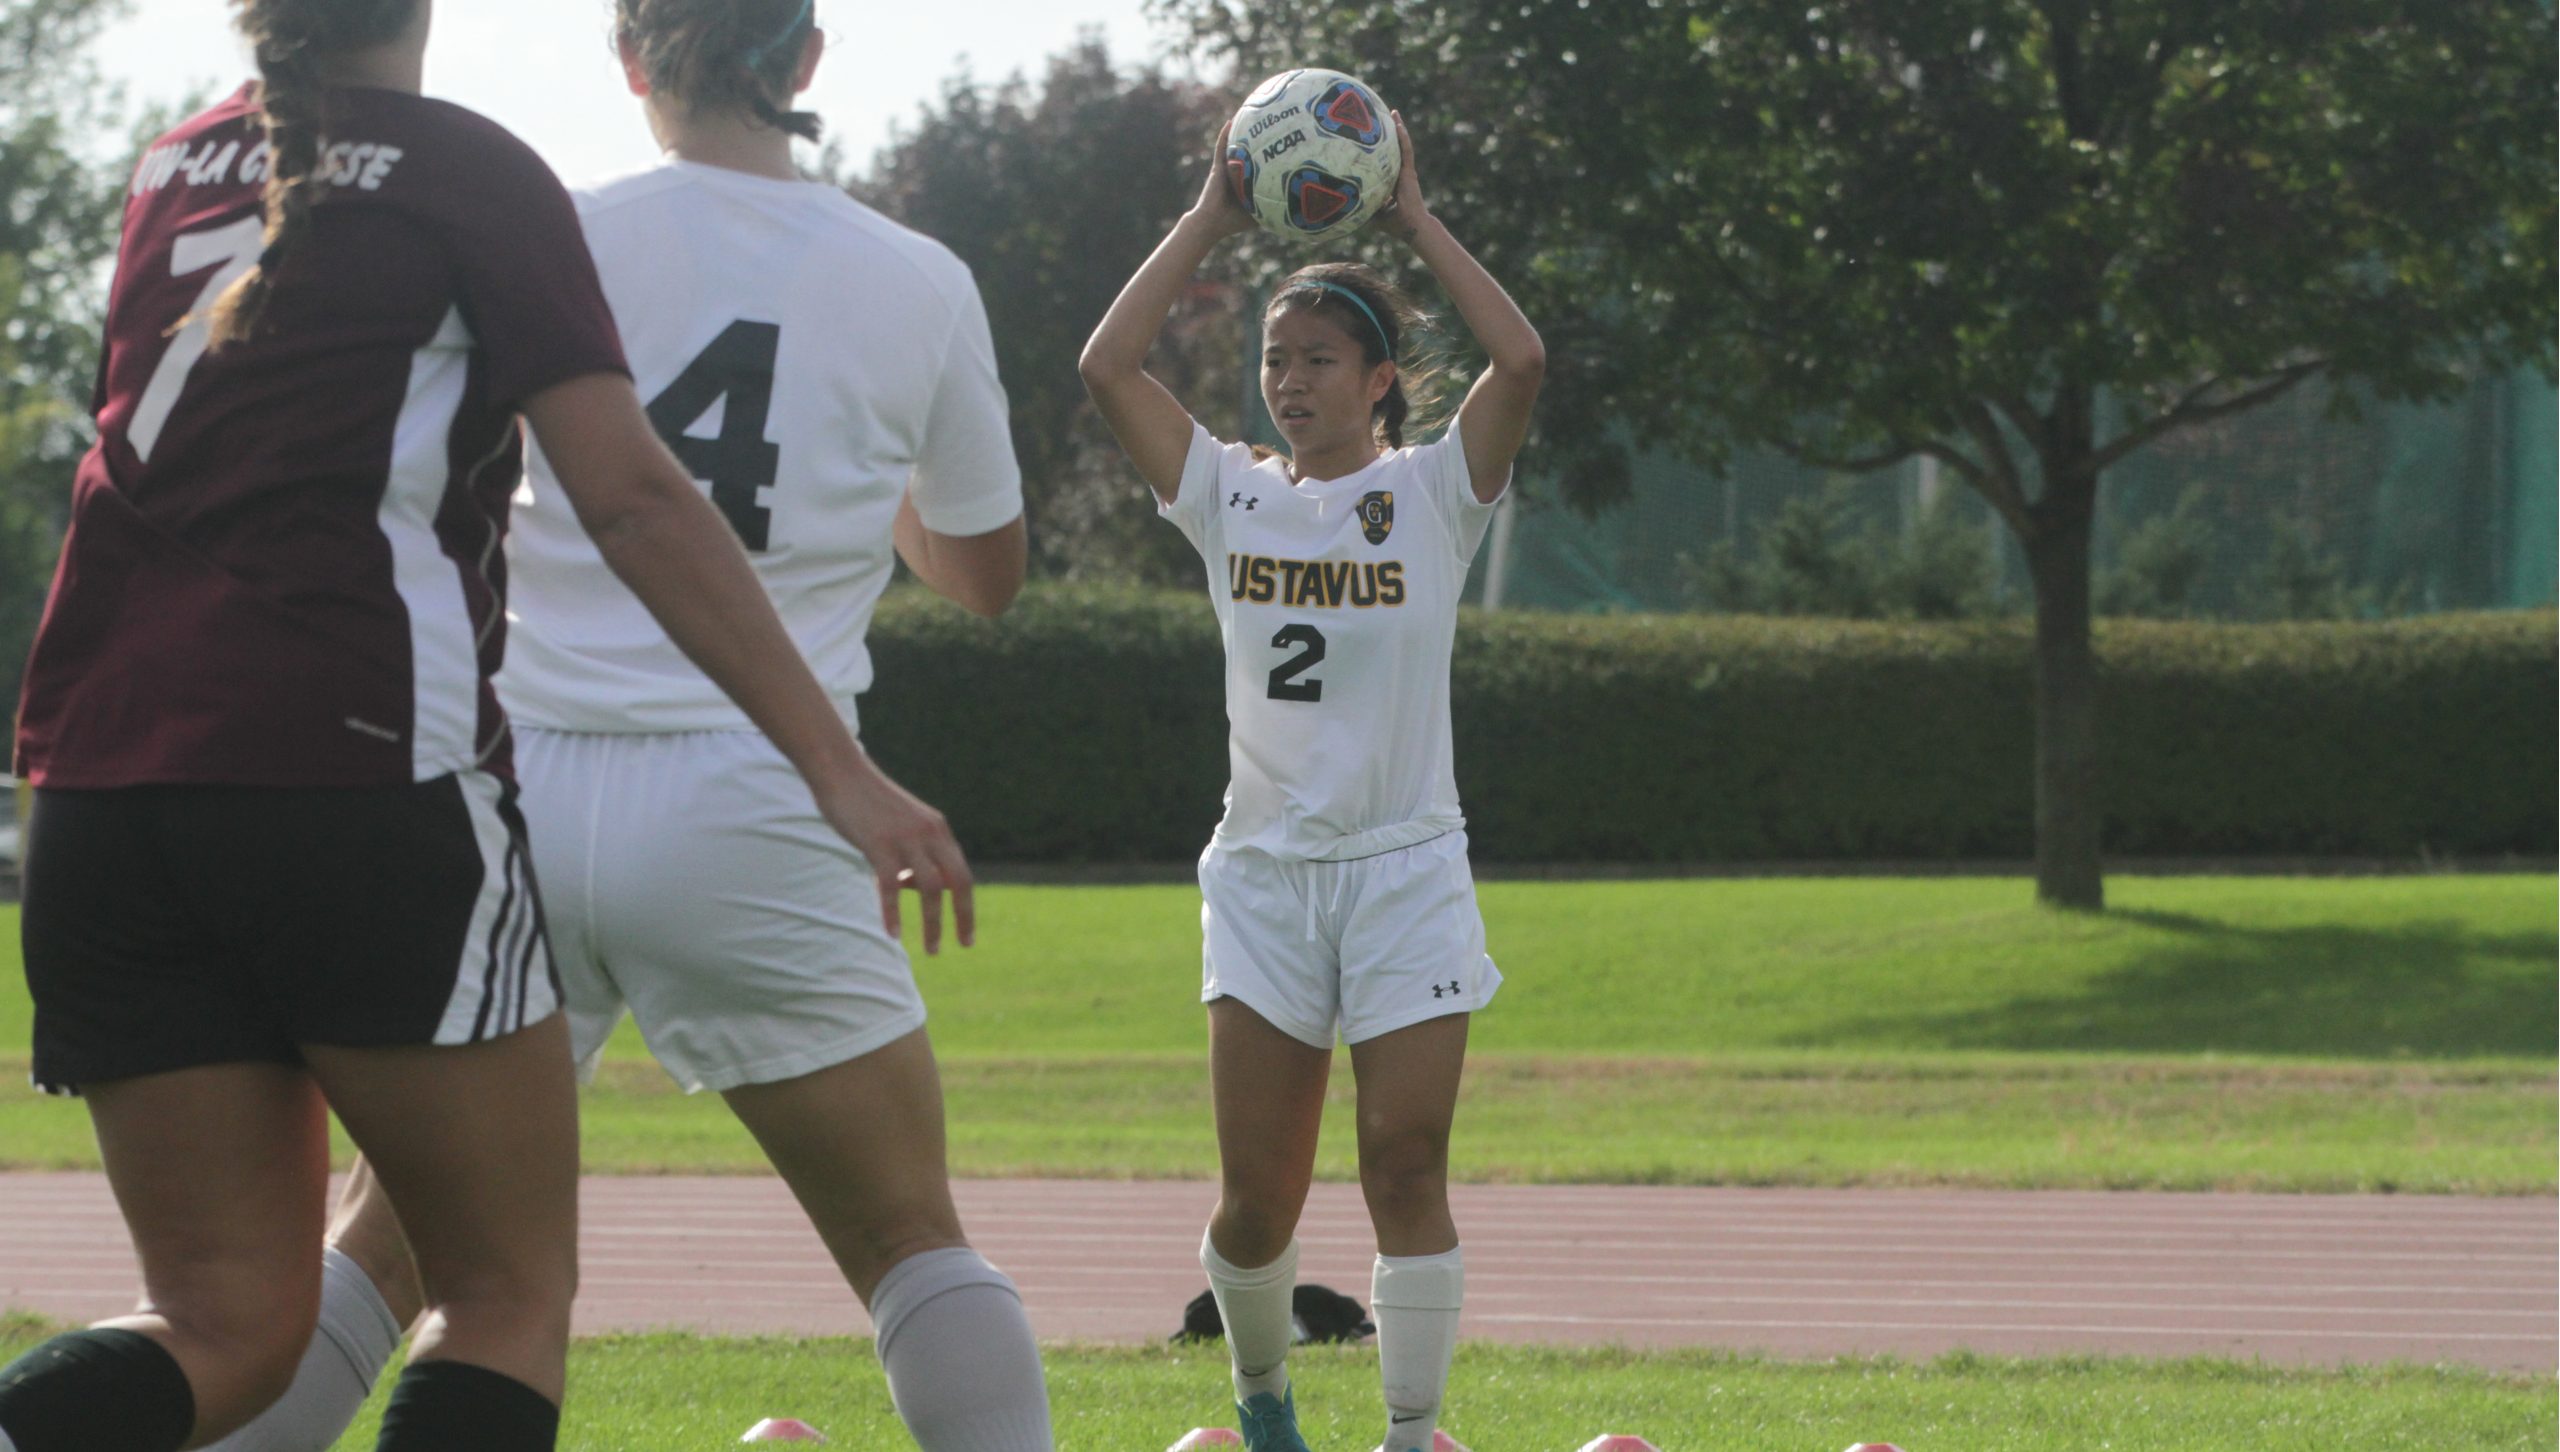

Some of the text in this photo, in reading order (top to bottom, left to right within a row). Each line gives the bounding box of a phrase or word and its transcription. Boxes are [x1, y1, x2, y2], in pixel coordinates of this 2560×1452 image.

[1248, 104, 1300, 139] Wilson
[1262, 128, 1307, 163] NCAA
[238, 136, 403, 191] CSSE
[127, 214, 265, 464] 7
[646, 319, 780, 552] 4
[1267, 623, 1326, 702] 2
